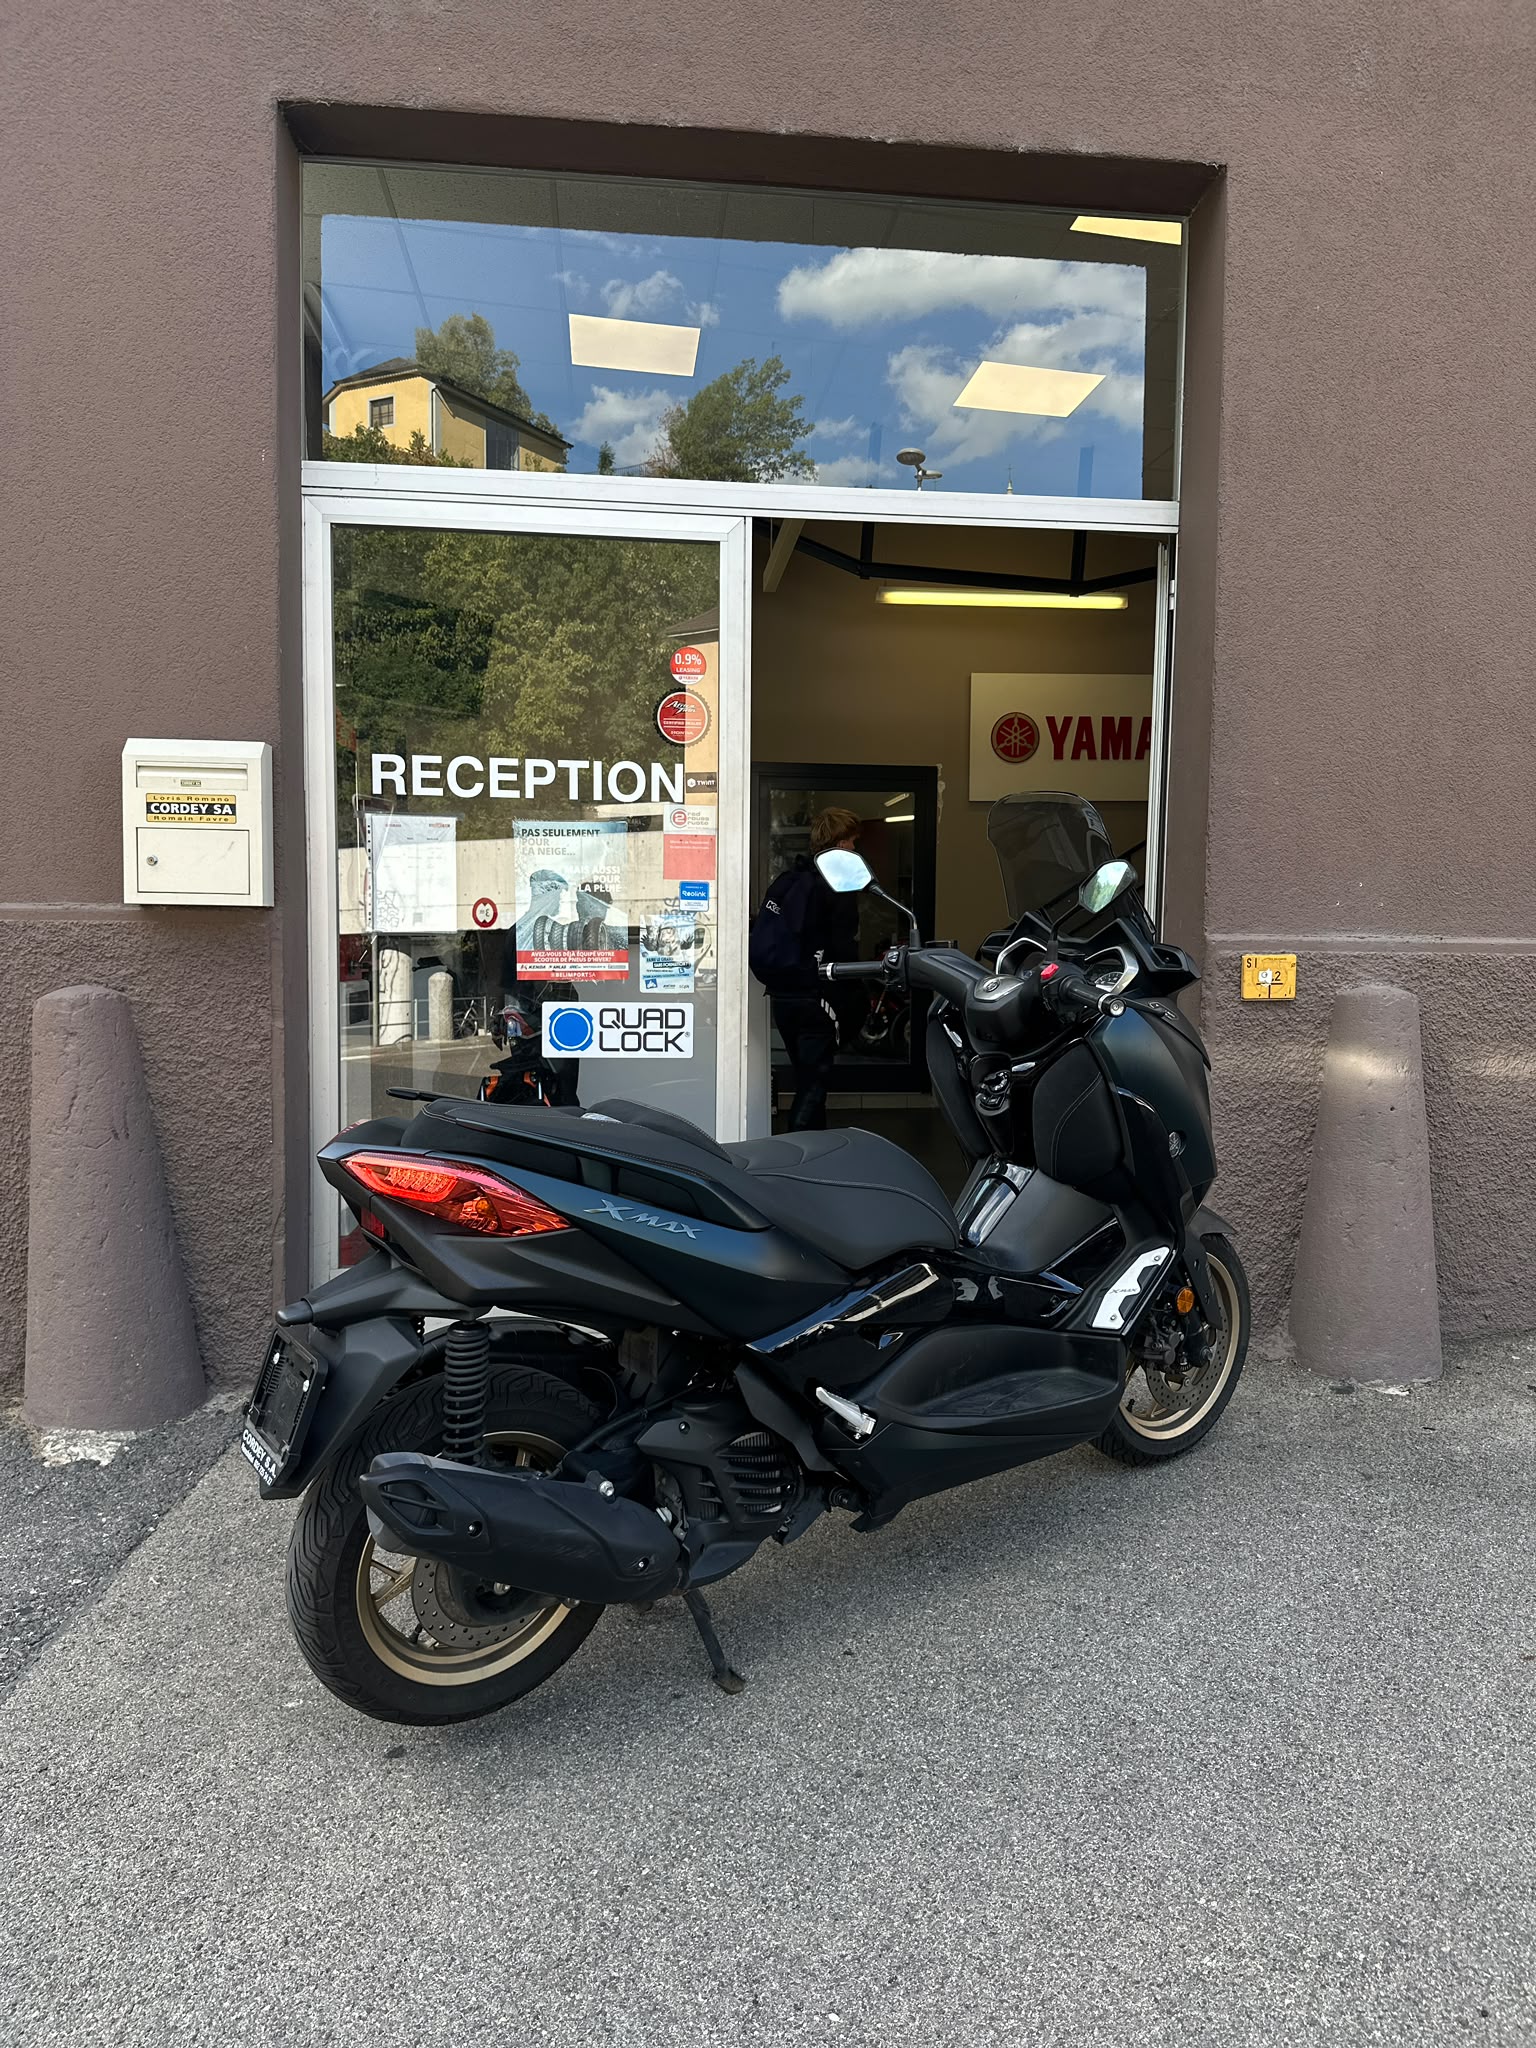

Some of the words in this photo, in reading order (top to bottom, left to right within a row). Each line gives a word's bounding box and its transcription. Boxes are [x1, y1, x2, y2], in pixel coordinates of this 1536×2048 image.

[674, 653, 702, 665] 0.9%
[371, 753, 684, 803] RECEPTION
[150, 803, 208, 814] CORDEY
[213, 804, 232, 814] SA
[522, 829, 540, 837] PAS
[542, 829, 600, 837] SEULEMENT
[592, 866, 620, 874] AUSSI
[593, 875, 620, 883] POUR
[579, 884, 591, 892] LA
[599, 1008, 685, 1029] QUAD
[243, 1429, 267, 1461] CORDEY
